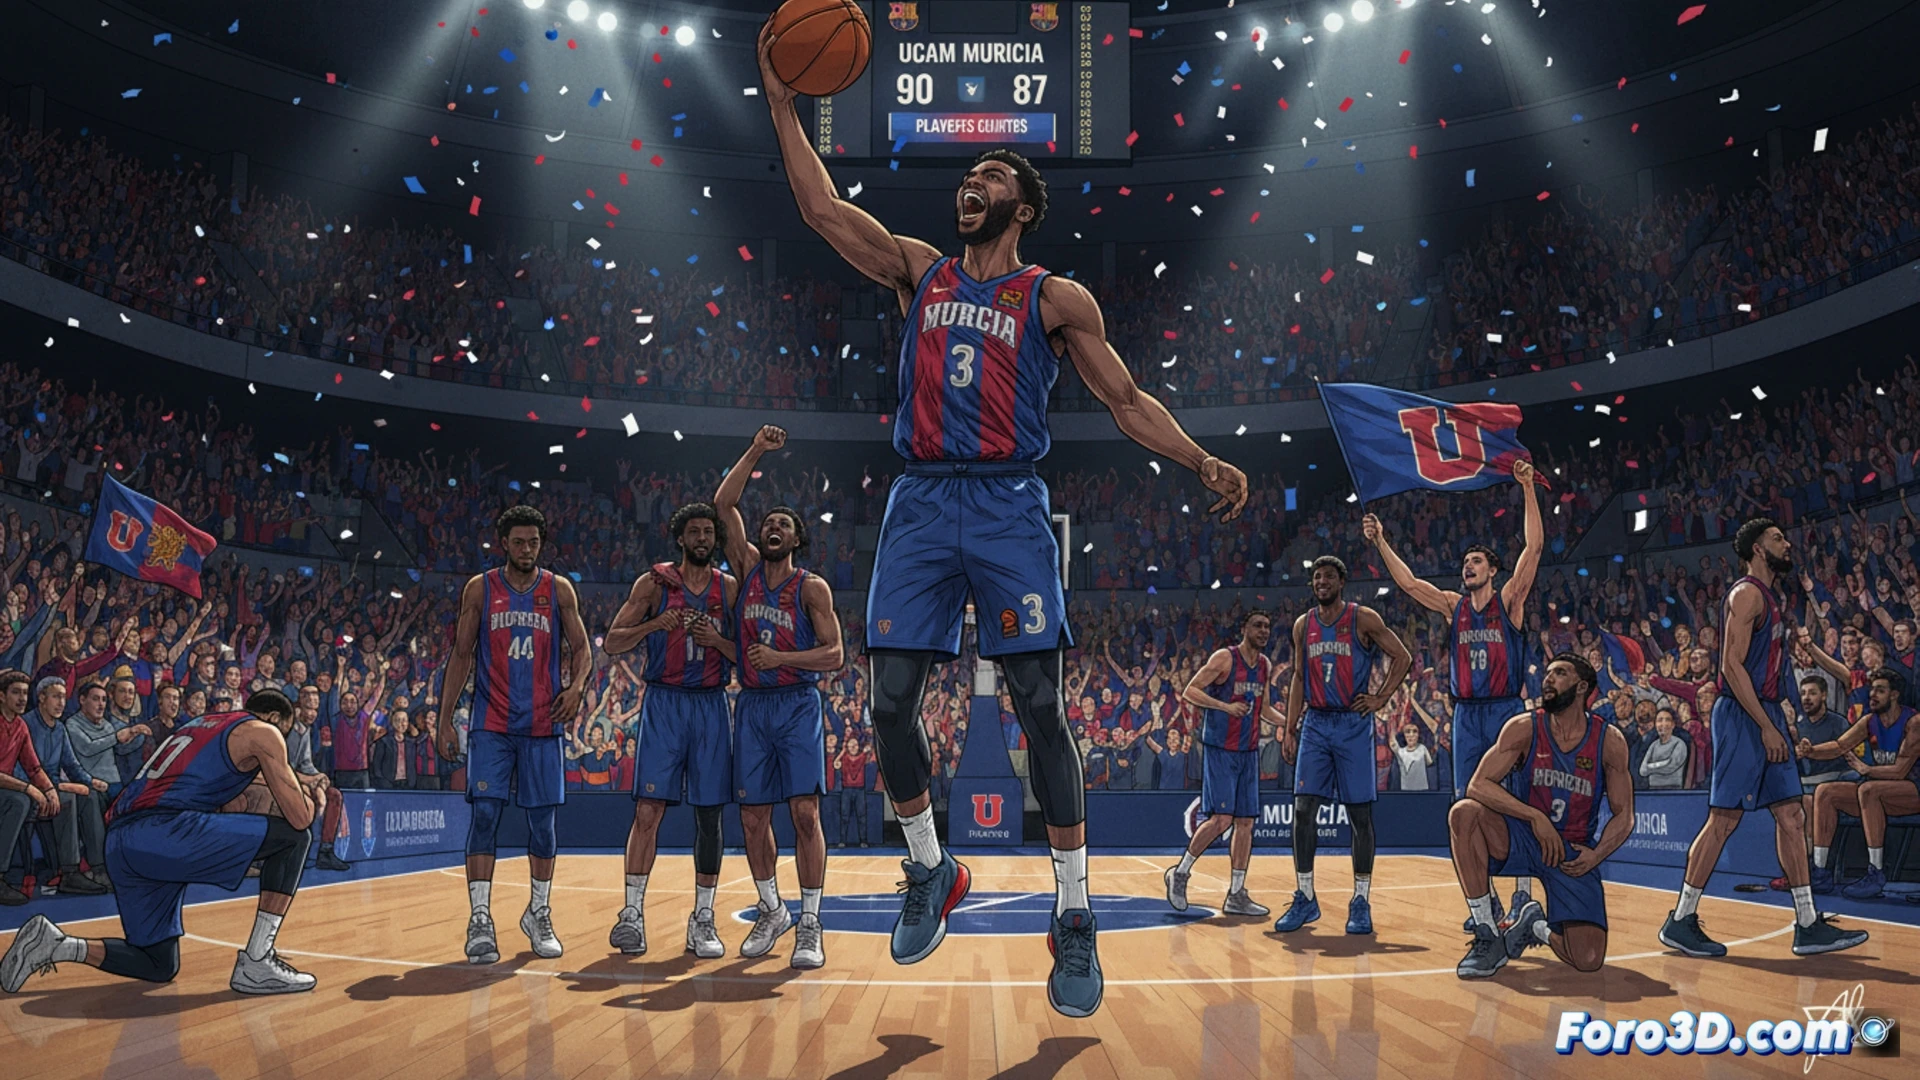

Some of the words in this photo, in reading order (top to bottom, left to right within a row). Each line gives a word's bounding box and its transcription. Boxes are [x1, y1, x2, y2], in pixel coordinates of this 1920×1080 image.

[899, 43, 956, 63] UCAM
[963, 42, 1044, 63] MURICIA
[896, 73, 934, 105] 90
[1013, 74, 1048, 105] 87
[922, 302, 1016, 348] MURCIA
[950, 344, 975, 388] 3
[1398, 406, 1486, 485] U
[107, 510, 144, 552] U
[1022, 593, 1046, 634] 3
[1322, 662, 1333, 683] 7
[971, 794, 1004, 828] U
[1263, 803, 1349, 825] MUCIA
